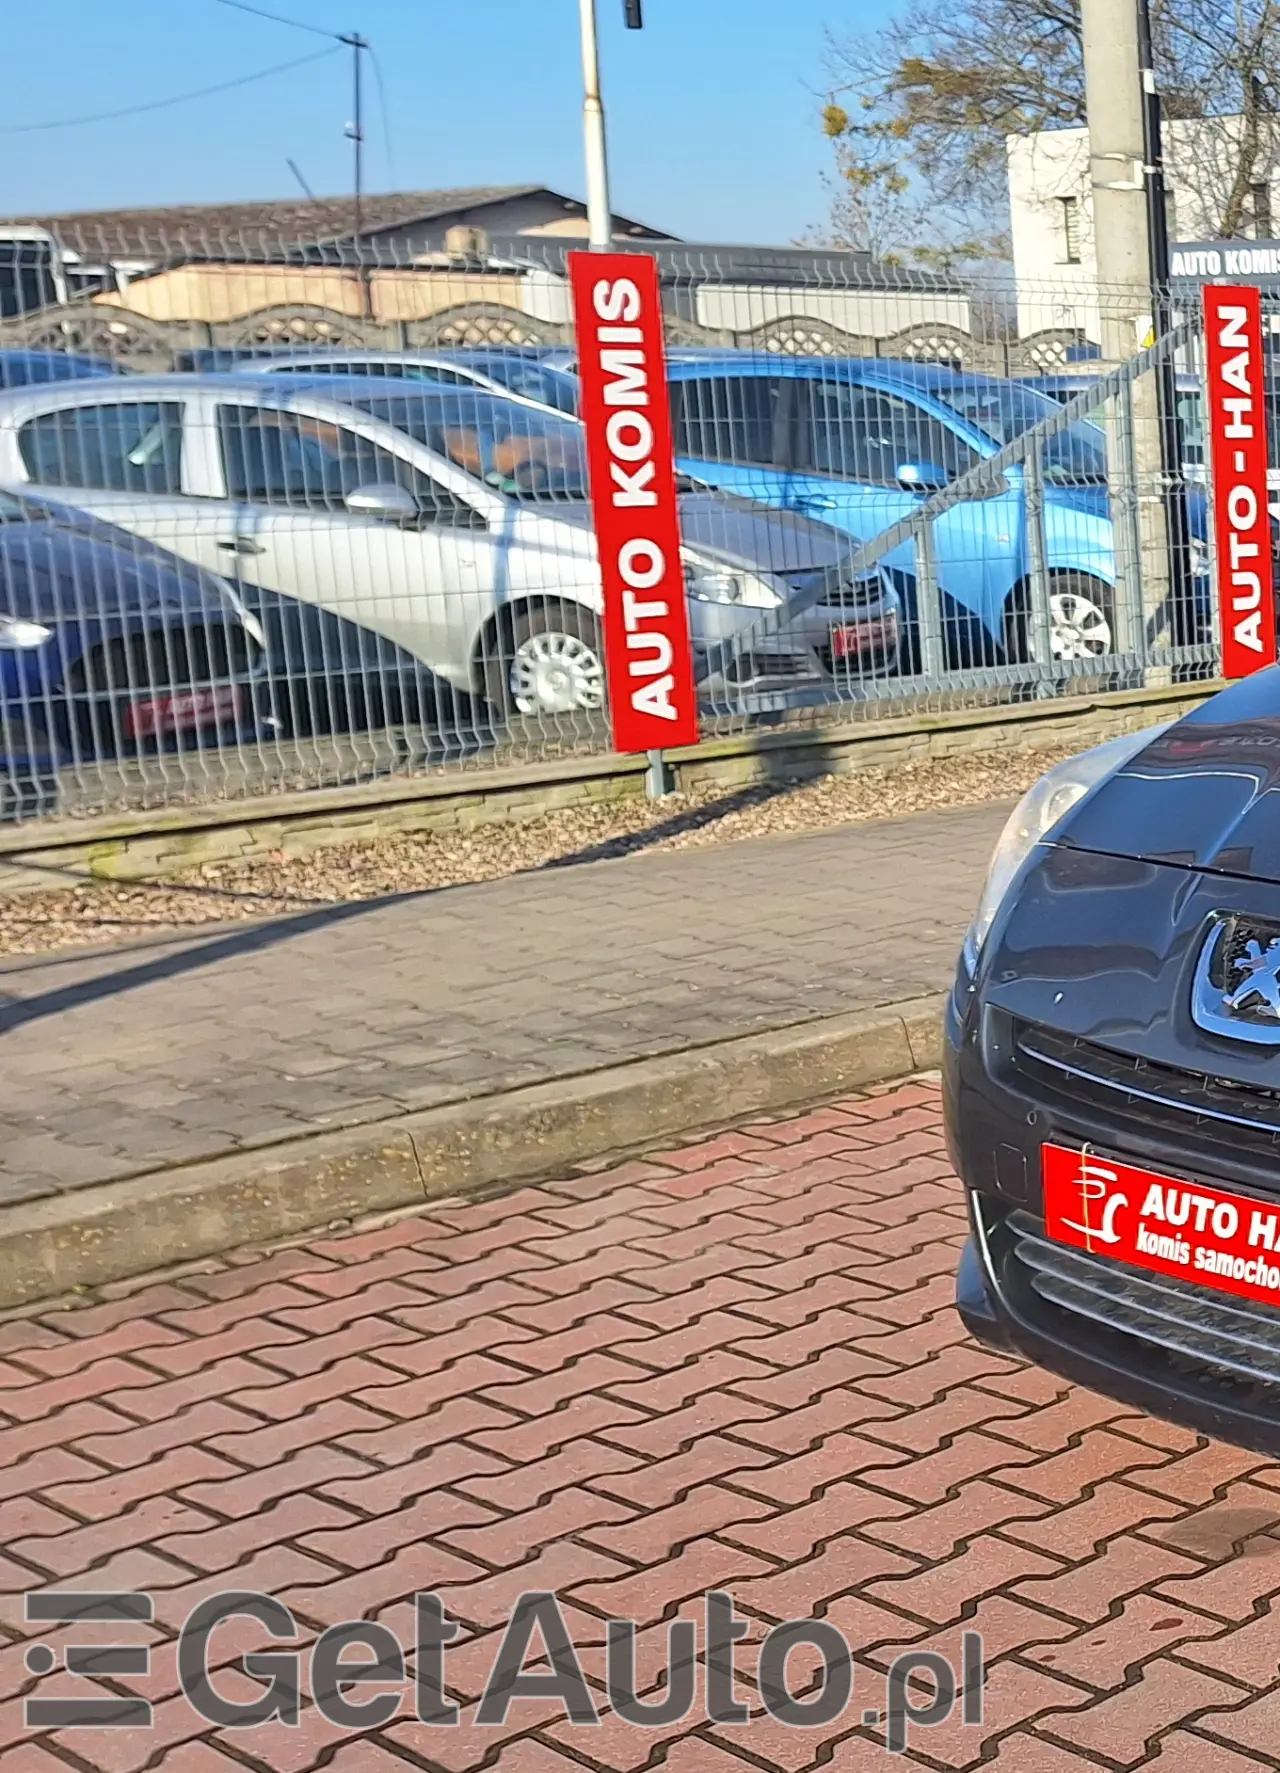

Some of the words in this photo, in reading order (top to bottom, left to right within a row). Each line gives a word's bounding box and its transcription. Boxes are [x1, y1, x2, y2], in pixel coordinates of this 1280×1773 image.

[1171, 250, 1222, 277] AUTO
[592, 277, 657, 507] KOMIS
[617, 538, 678, 721] AUTO
[1139, 1183, 1239, 1239] AUTO
[1136, 1222, 1190, 1265] komis
